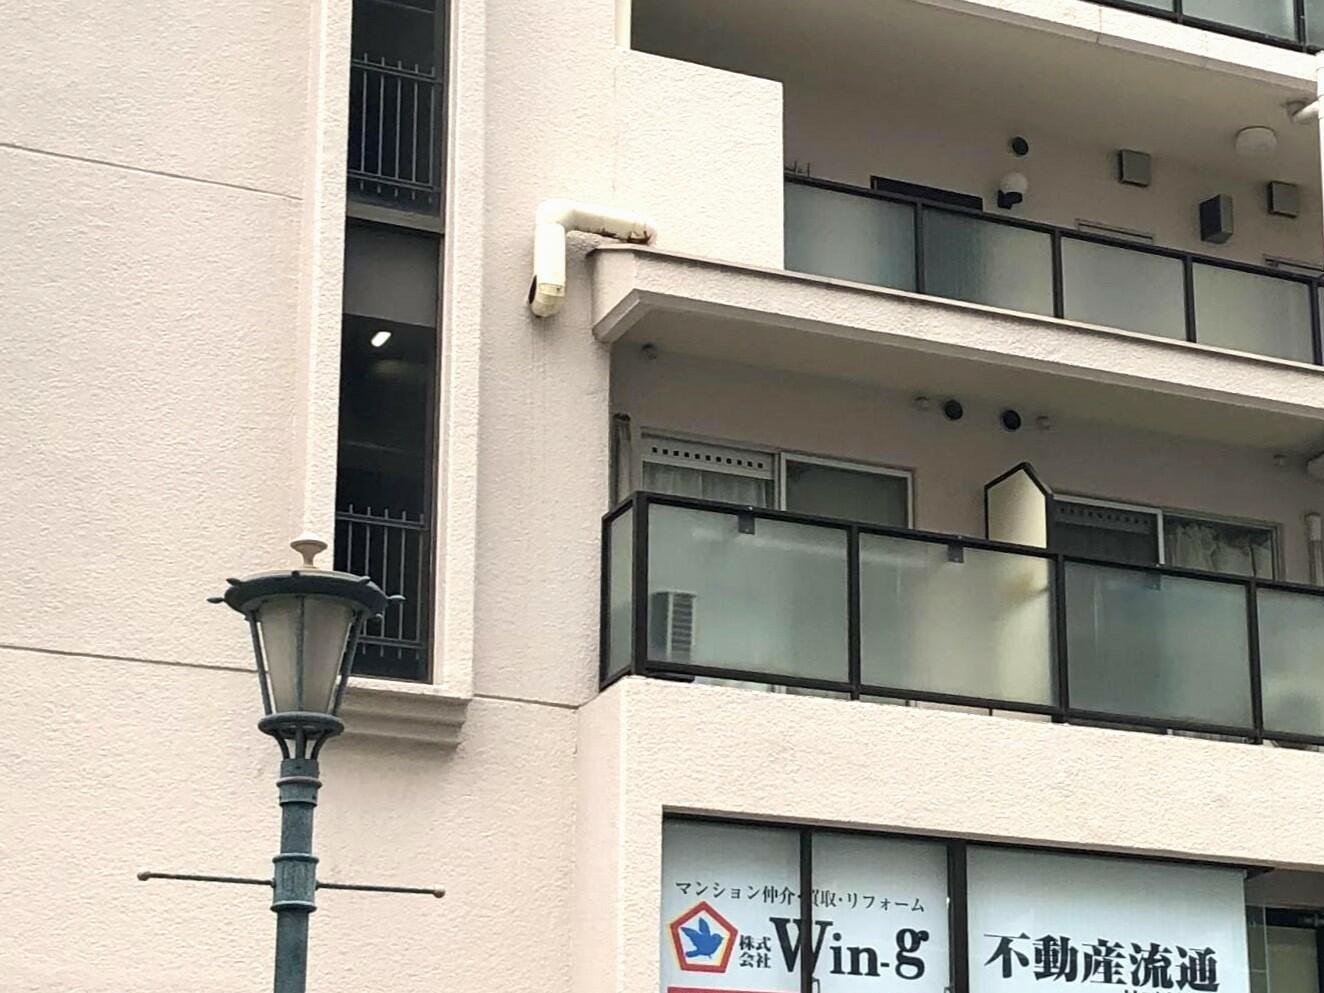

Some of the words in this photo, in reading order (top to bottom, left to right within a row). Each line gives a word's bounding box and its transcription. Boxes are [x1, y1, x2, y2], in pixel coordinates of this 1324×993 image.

[769, 916, 930, 980] Win-g
[984, 932, 1220, 992] 不動産流通
